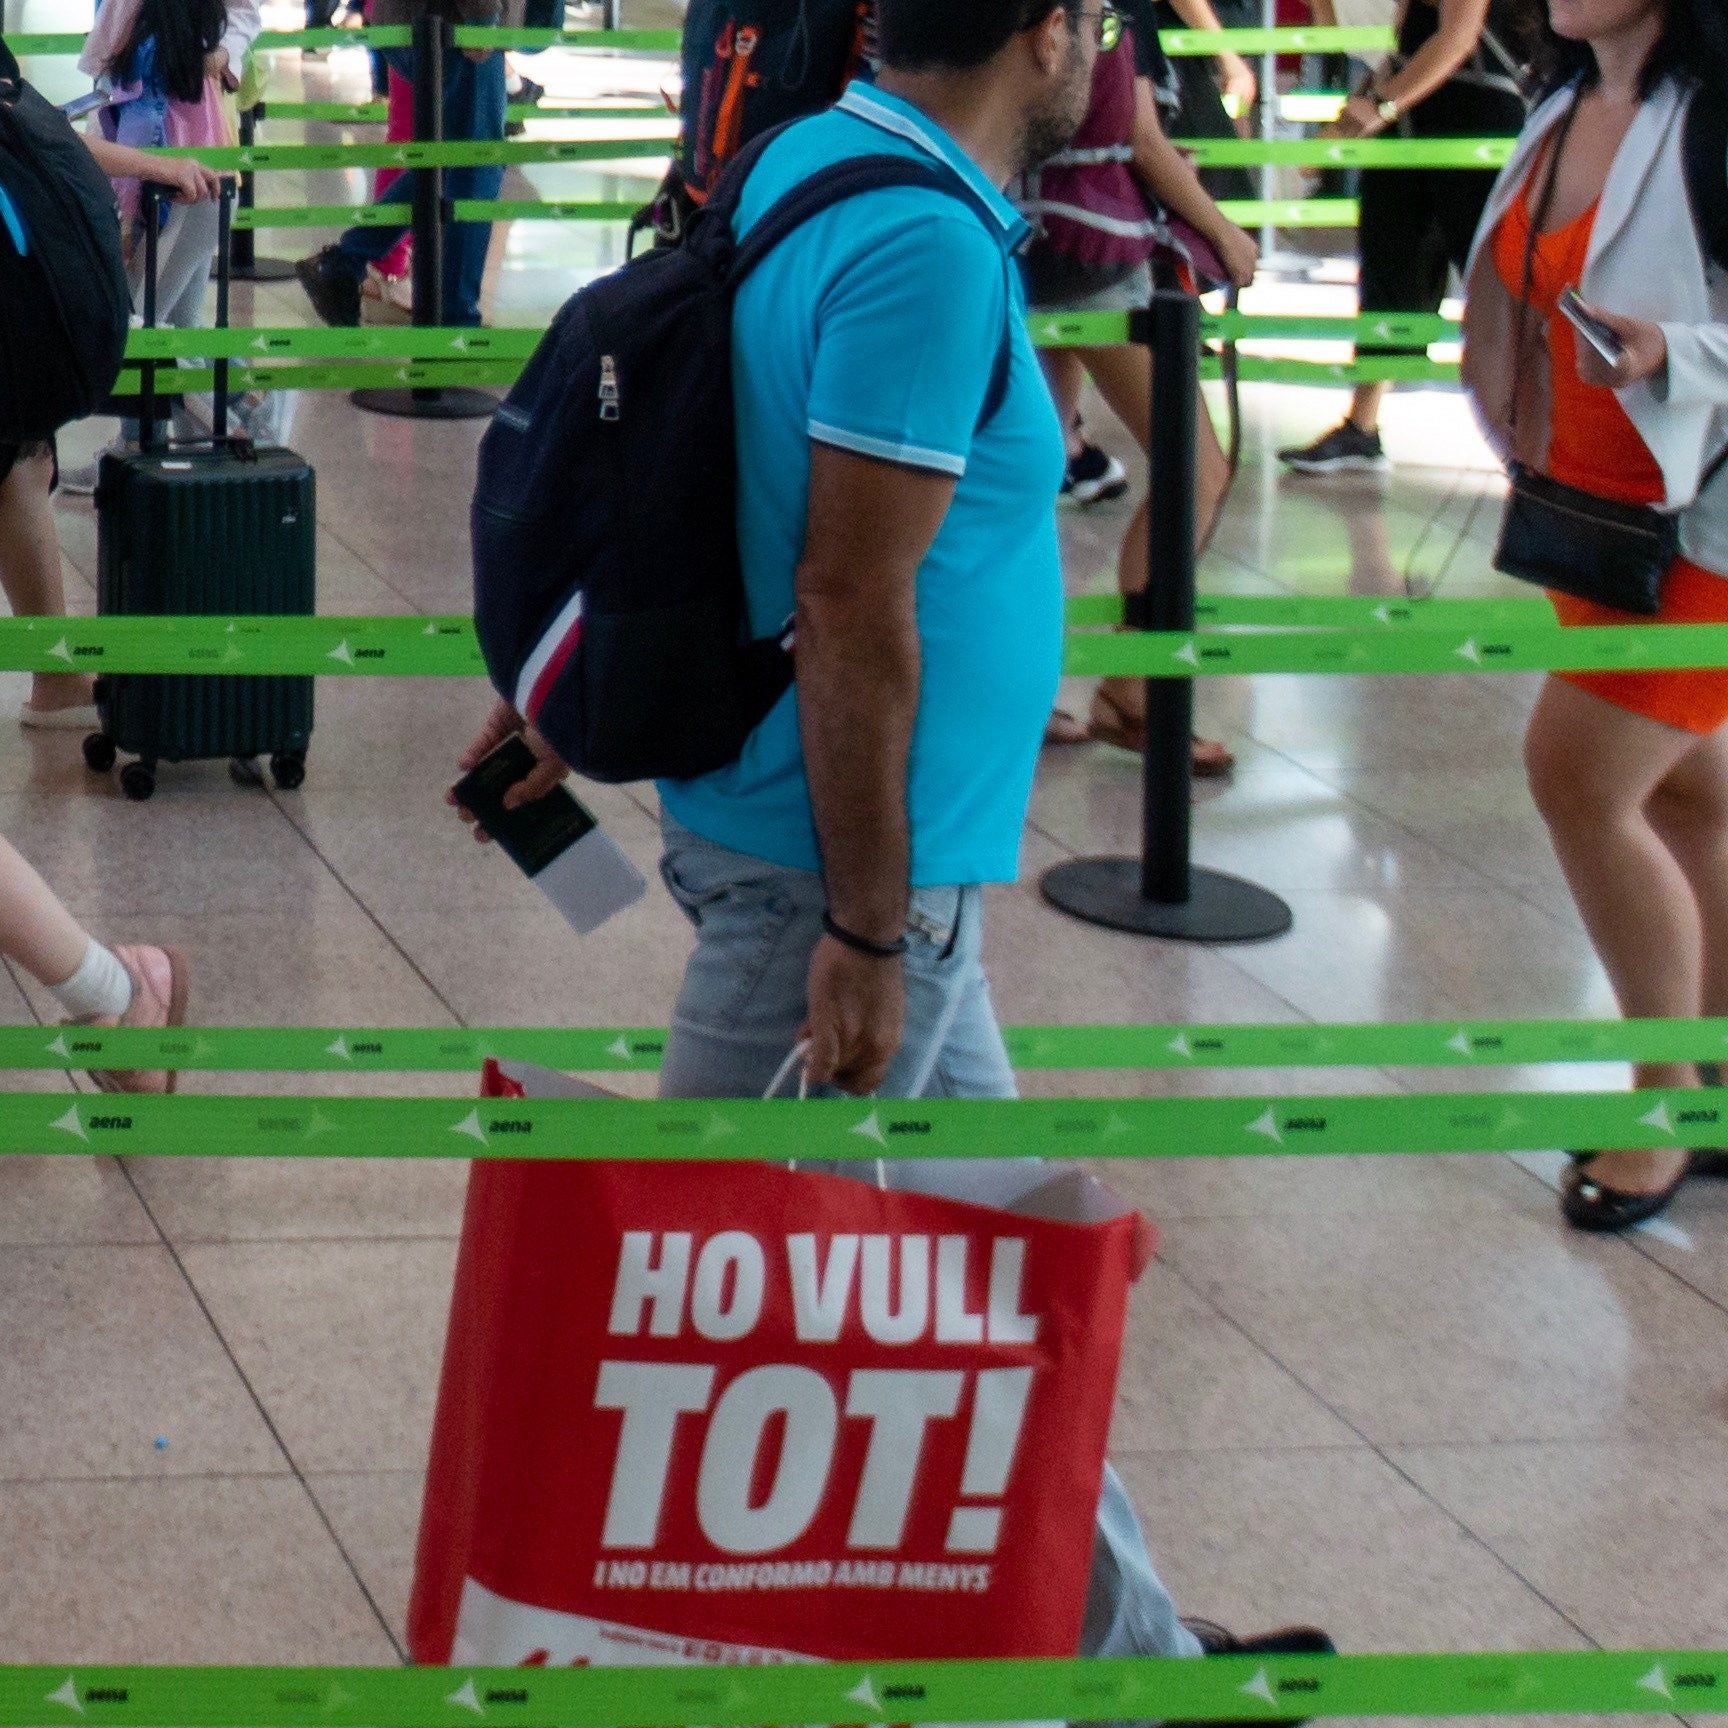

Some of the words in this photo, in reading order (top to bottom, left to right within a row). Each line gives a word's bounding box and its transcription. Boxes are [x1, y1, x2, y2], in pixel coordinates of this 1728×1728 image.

[89, 1116, 133, 1130] aena
[489, 1120, 533, 1133] aena
[606, 1230, 767, 1342] HO
[786, 1233, 1042, 1345] VULL
[593, 1358, 1036, 1555] TOT!
[592, 1560, 609, 1589] I
[609, 1560, 647, 1590] NO
[649, 1561, 692, 1591] EM
[694, 1560, 833, 1593] CONFORMO
[834, 1560, 895, 1592] AMB
[897, 1563, 992, 1594] MENYS
[85, 1688, 129, 1702] aena
